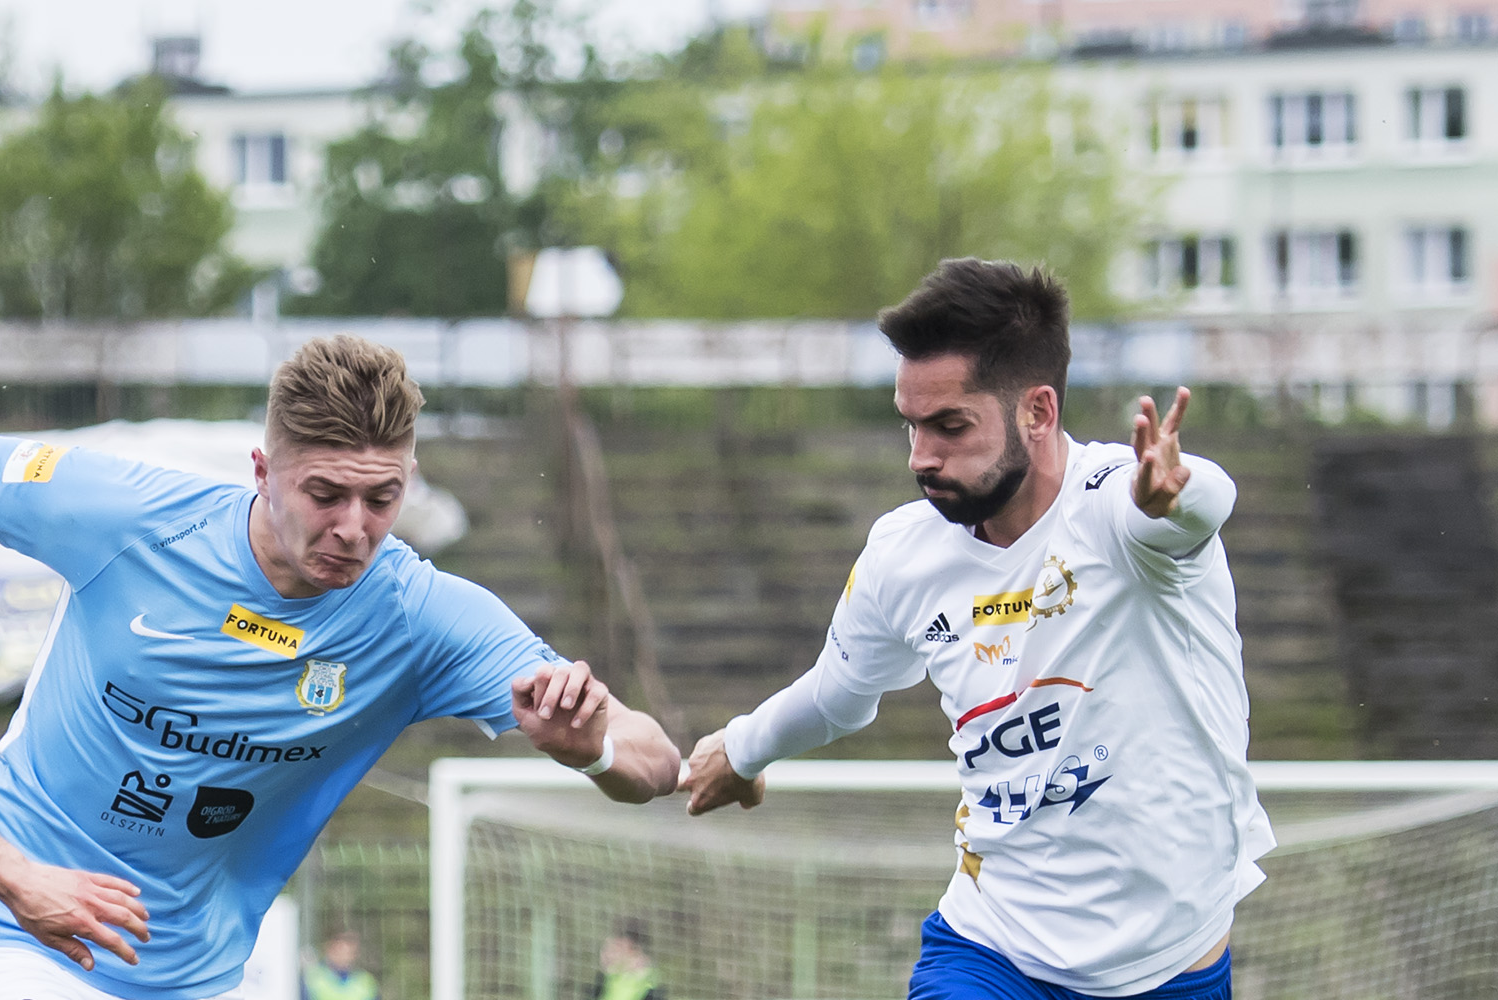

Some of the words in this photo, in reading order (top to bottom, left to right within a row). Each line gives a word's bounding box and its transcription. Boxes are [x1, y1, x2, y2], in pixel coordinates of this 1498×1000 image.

[159, 518, 208, 548] vitasport.pl
[973, 599, 1033, 618] FORTUN
[225, 613, 298, 649] FORTUNA
[160, 720, 328, 763] budimex
[100, 812, 166, 837] OLSZTYN
